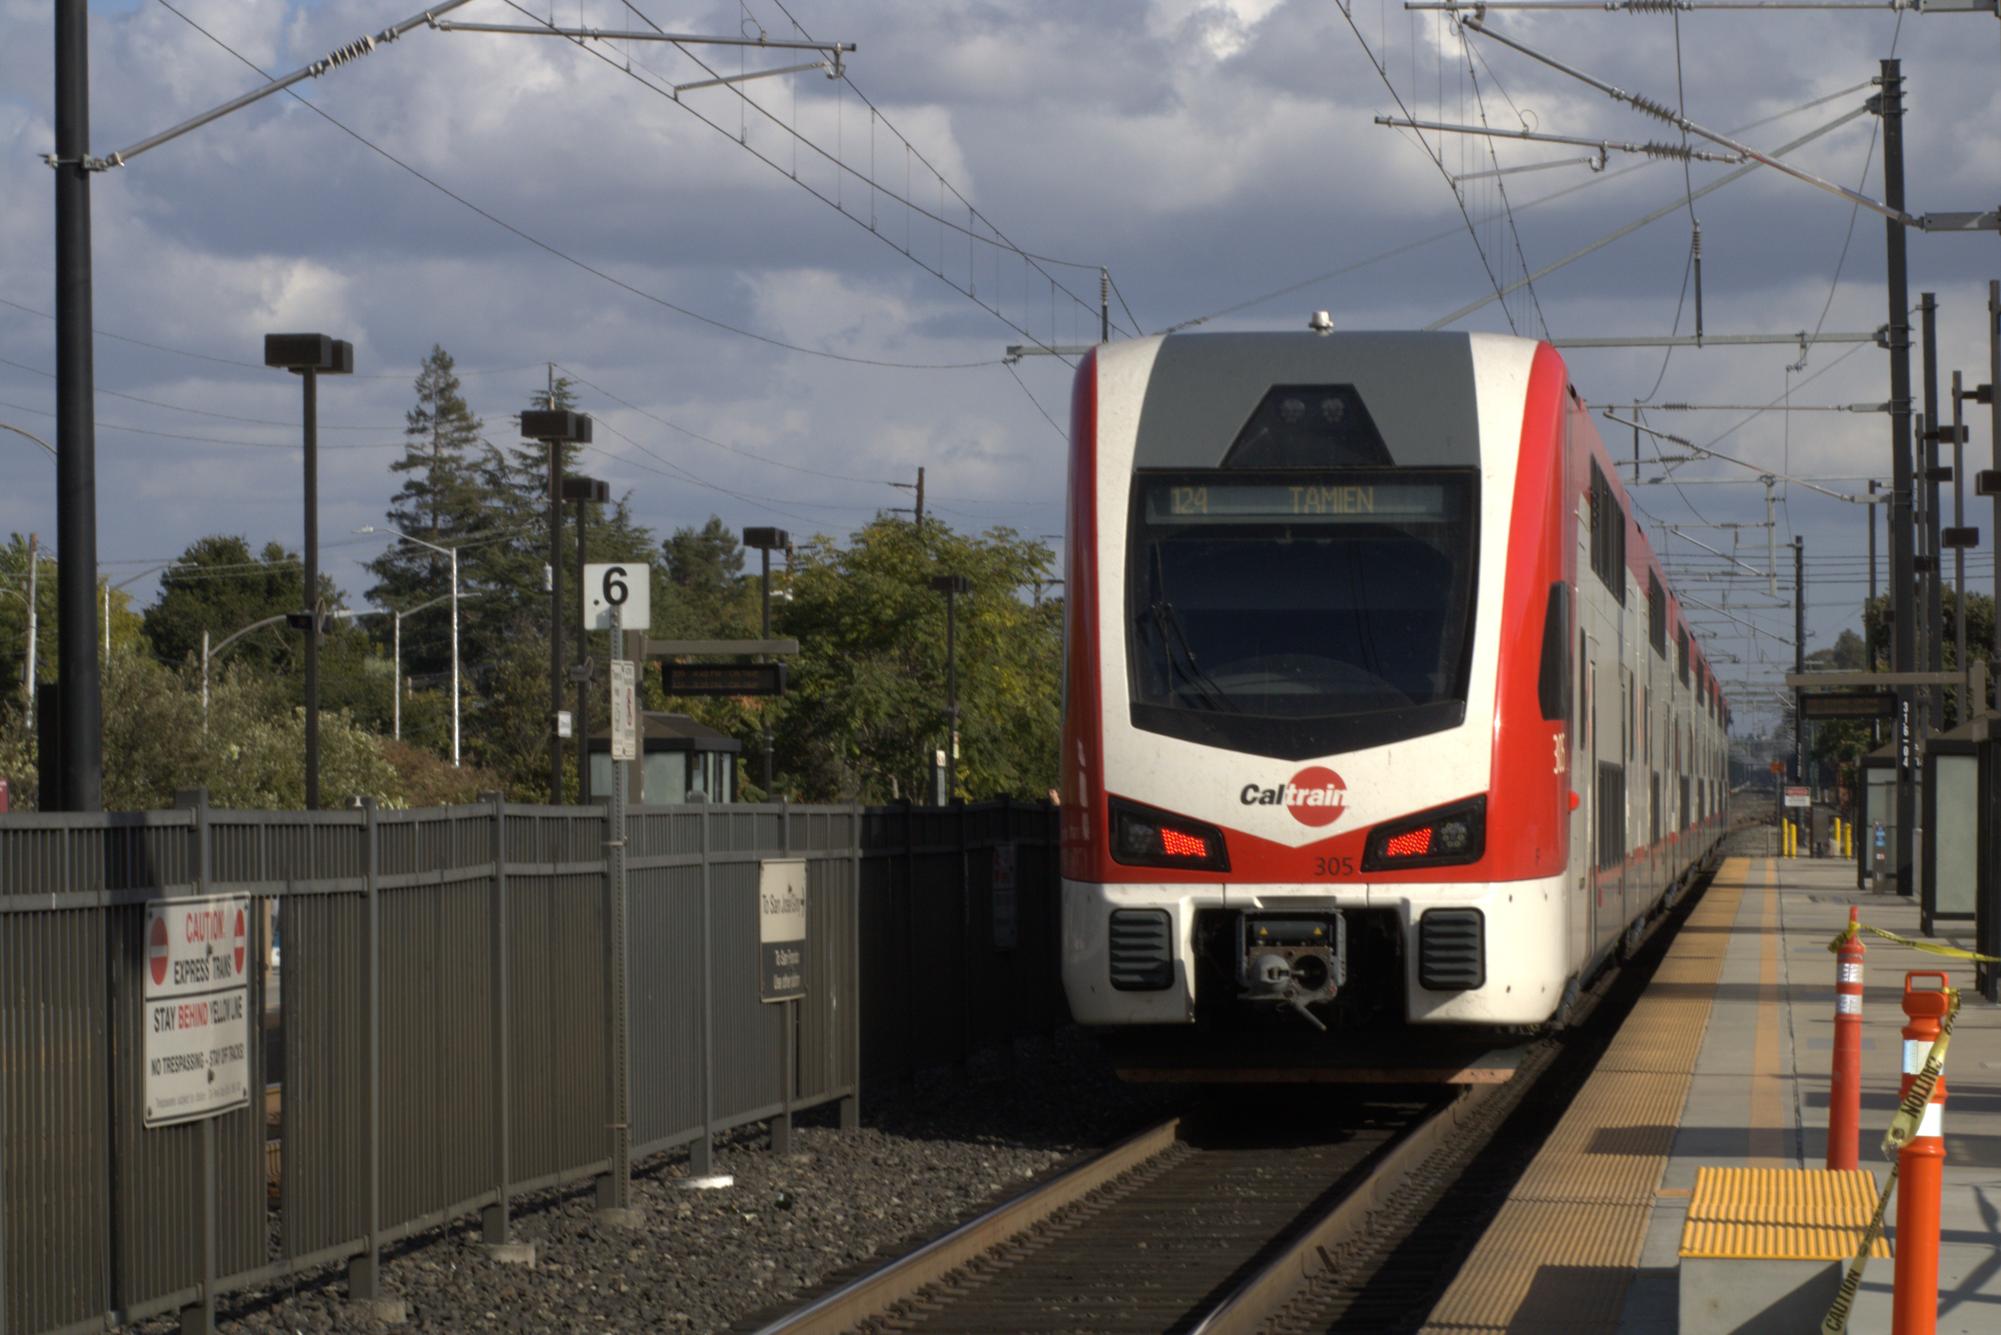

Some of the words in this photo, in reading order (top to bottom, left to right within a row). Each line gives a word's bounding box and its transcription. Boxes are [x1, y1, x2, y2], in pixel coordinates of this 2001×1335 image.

[1289, 486, 1374, 514] TAMIEN
[1240, 783, 1350, 807] Caltrain
[1315, 857, 1354, 876] 305
[174, 959, 209, 985] EXPRESS
[154, 1006, 176, 1033] STAY
[178, 1002, 208, 1030] BEHIND
[209, 998, 229, 1024] YELLOW
[230, 995, 243, 1020] LINE
[151, 1057, 161, 1077] NO
[162, 1051, 204, 1075] TRESPASSING
[1900, 1055, 1943, 1119] CAUTION
[1825, 1268, 1862, 1332] CAUTION
